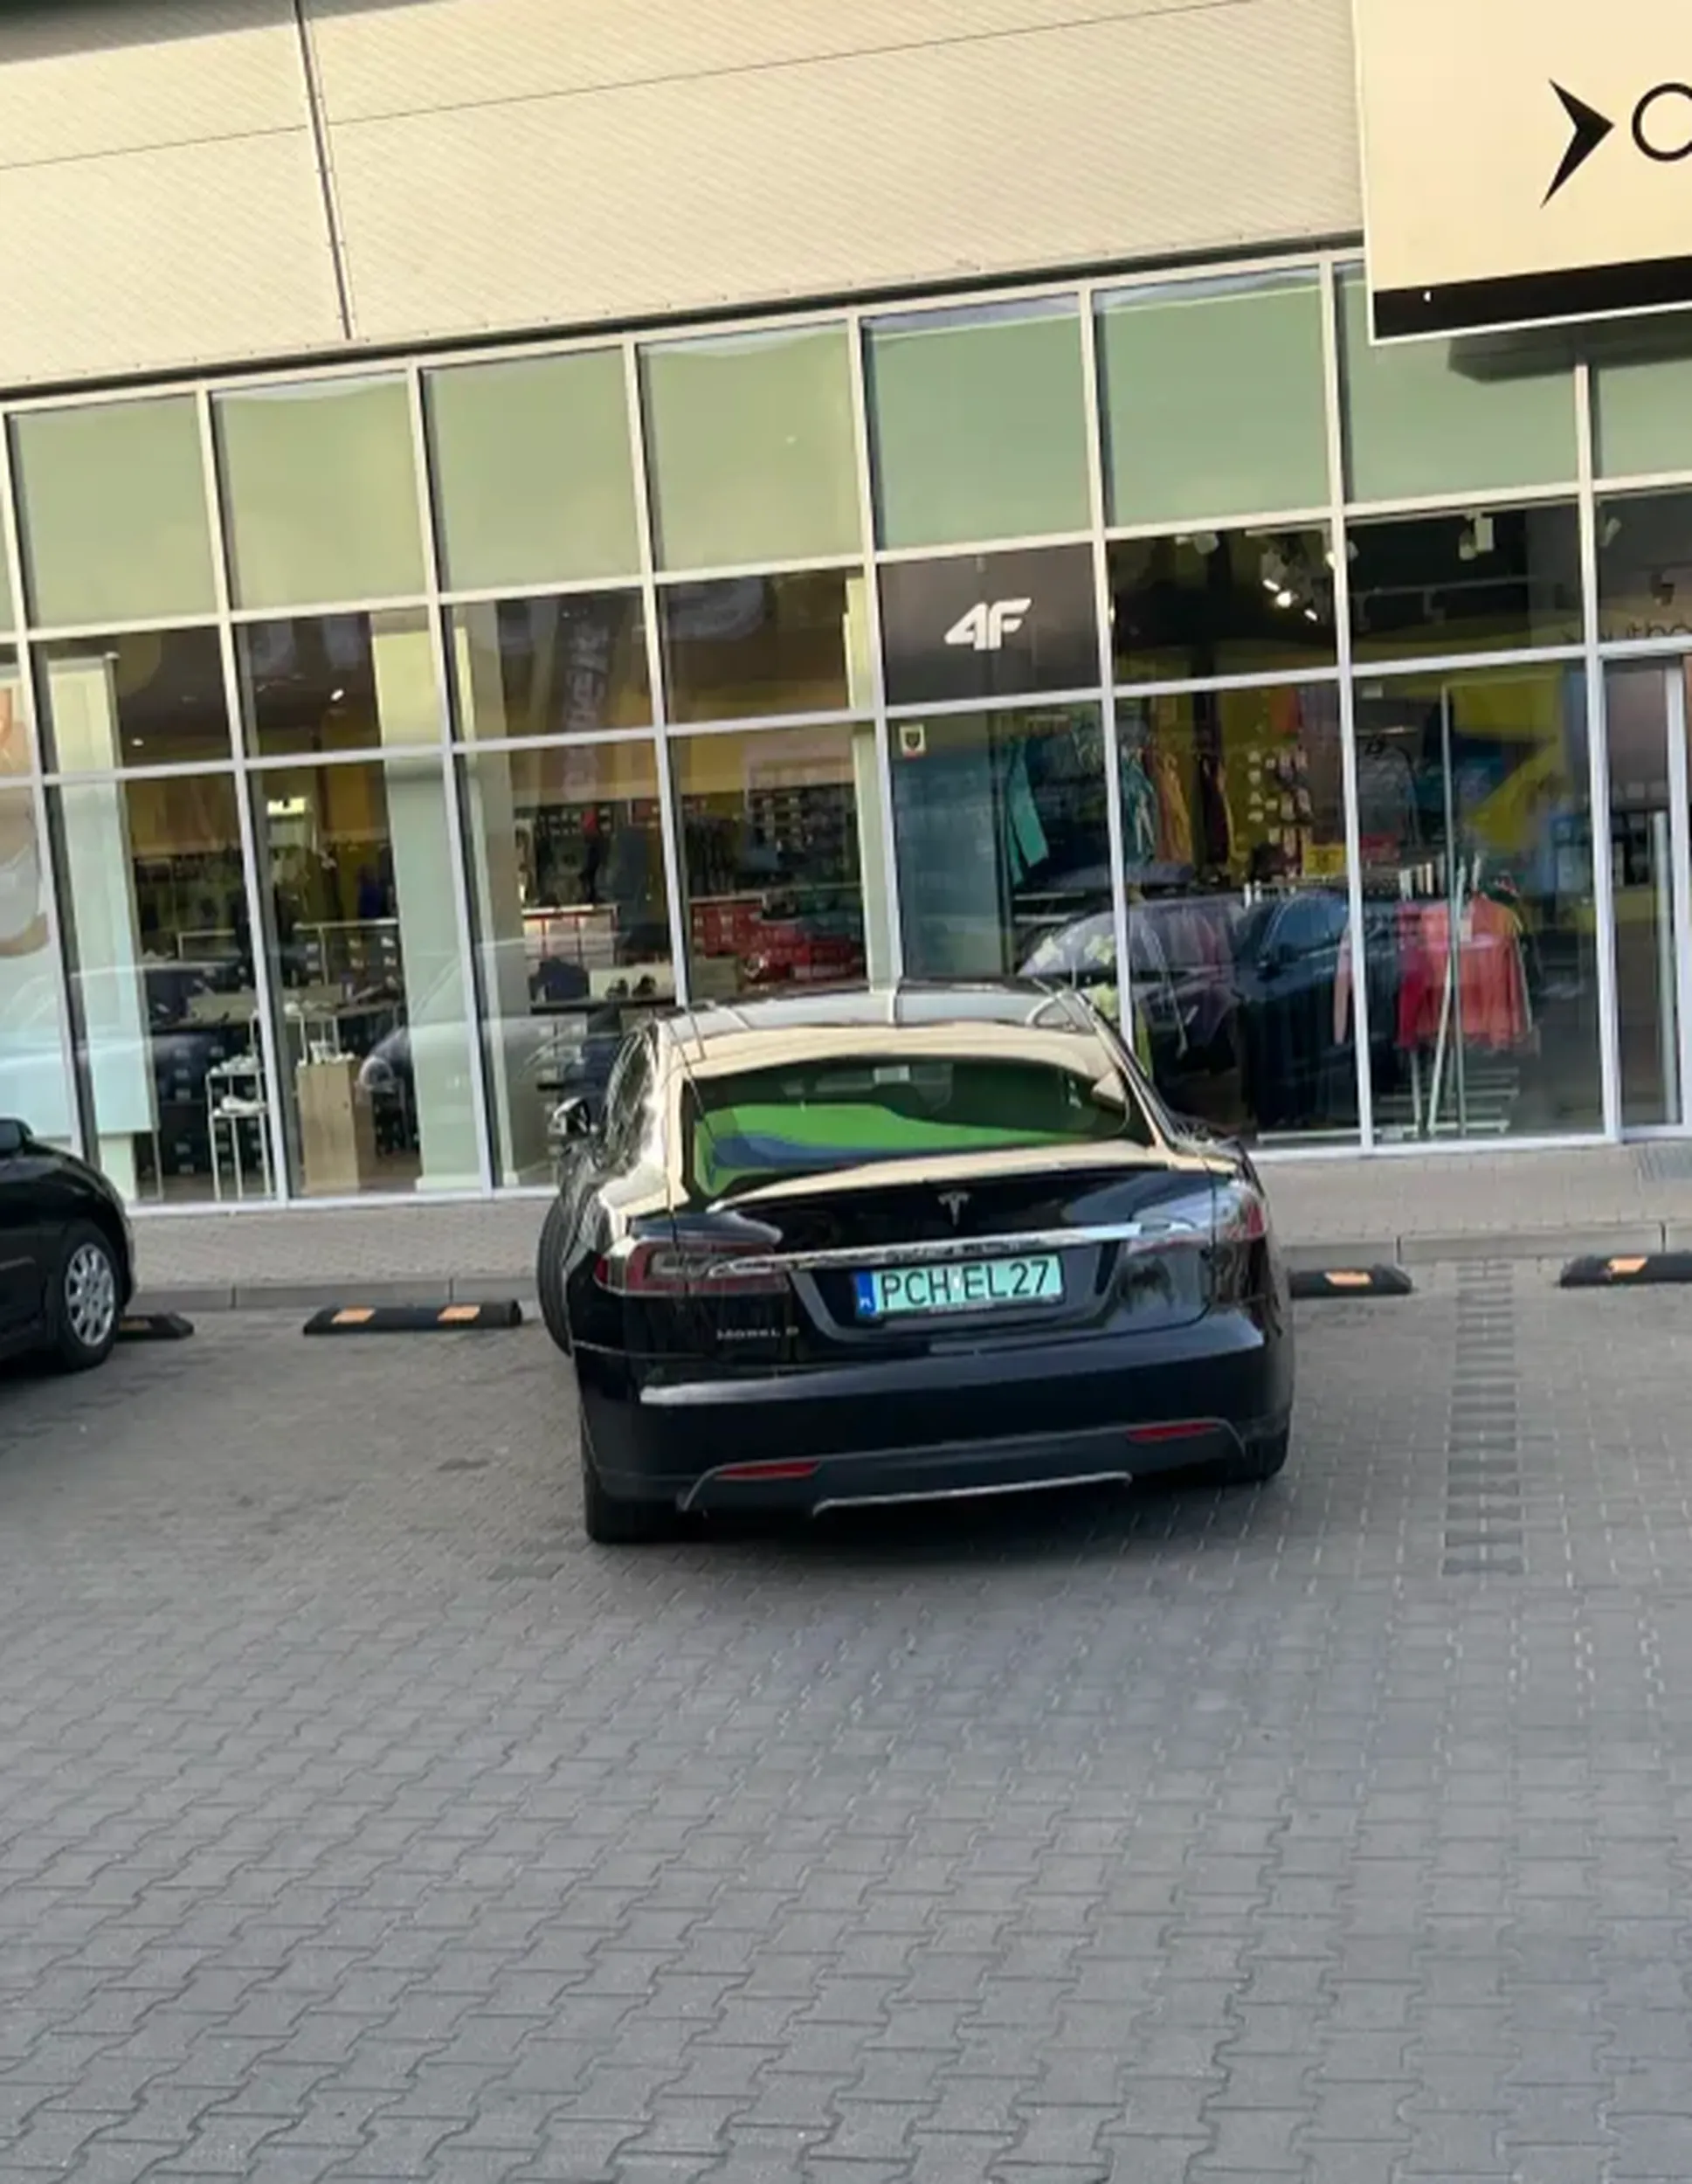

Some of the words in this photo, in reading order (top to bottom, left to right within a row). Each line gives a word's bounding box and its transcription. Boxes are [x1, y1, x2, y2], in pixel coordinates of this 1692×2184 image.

[944, 598, 1032, 650] 4F
[881, 1268, 951, 1308] PCH
[963, 1261, 1049, 1299] EL27
